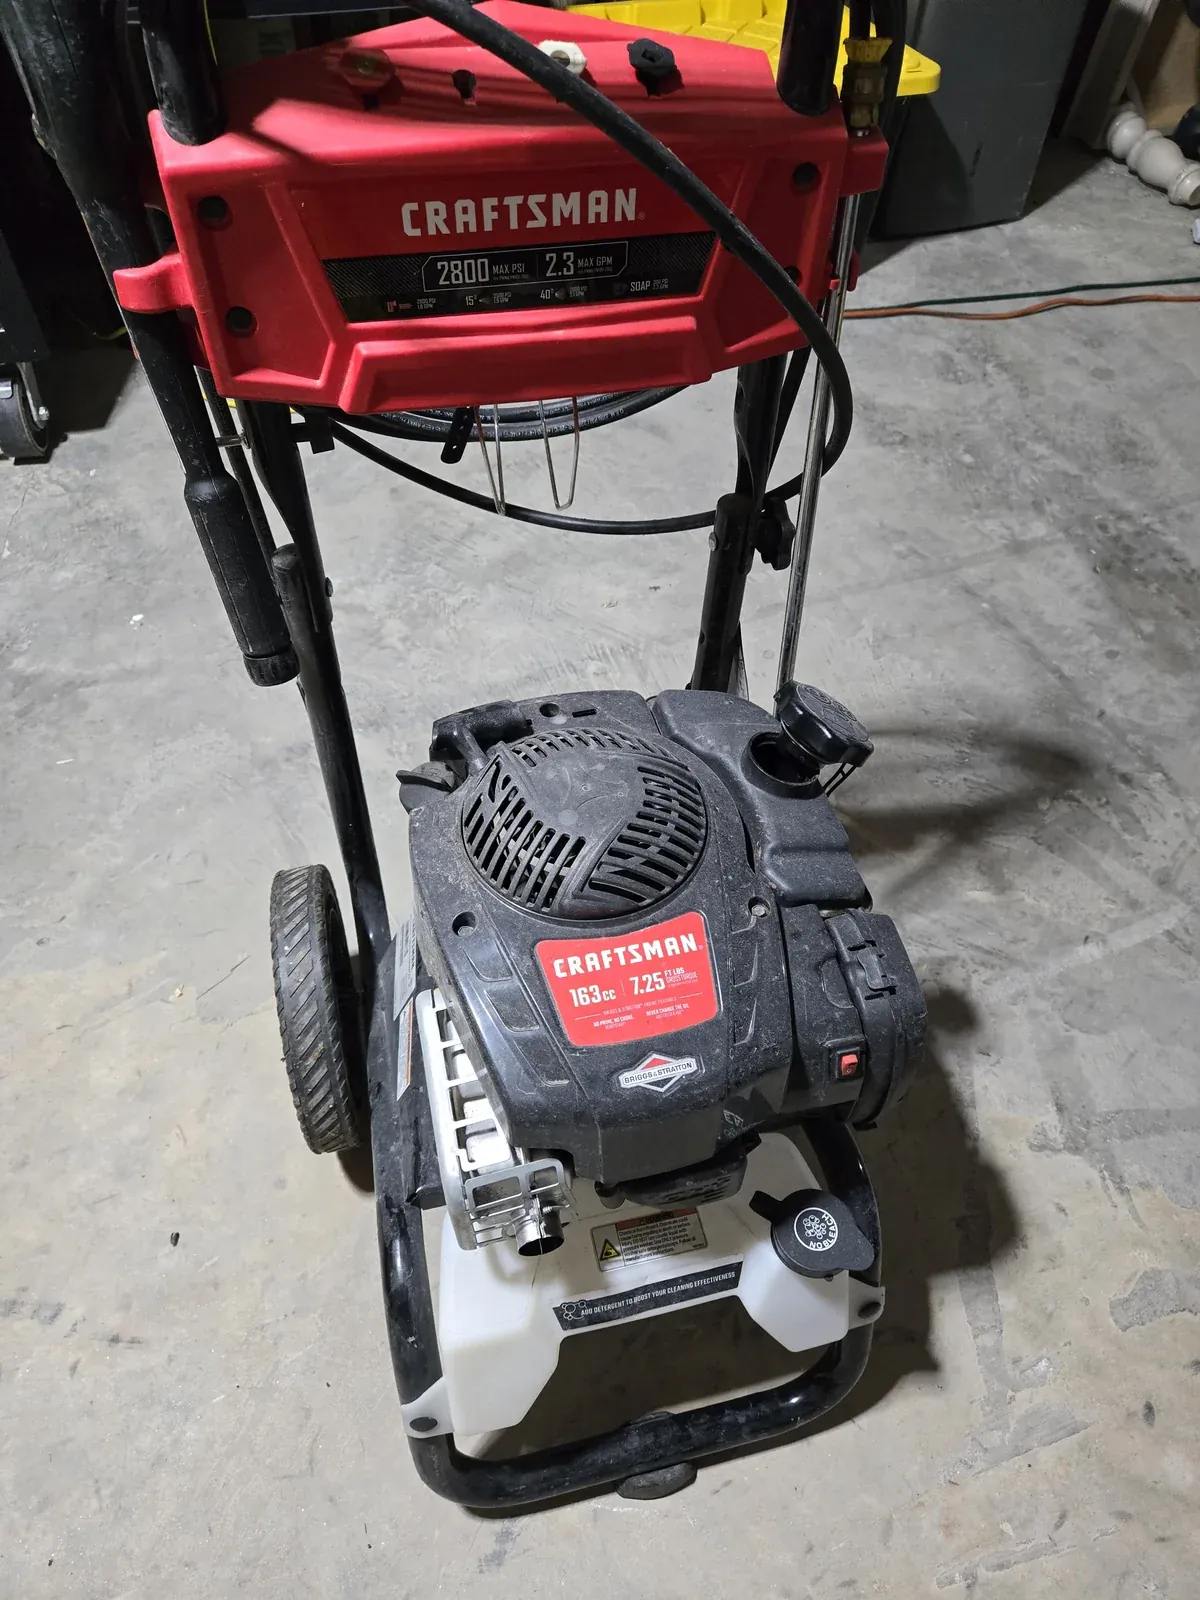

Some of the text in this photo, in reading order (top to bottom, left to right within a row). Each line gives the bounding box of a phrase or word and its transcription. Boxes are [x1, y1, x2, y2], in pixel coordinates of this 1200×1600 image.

[401, 188, 637, 236] CRAFTSMAN
[437, 258, 489, 285] 2800
[492, 264, 509, 274] MAX
[512, 263, 525, 273] PSI
[545, 252, 574, 277] 2.3
[577, 258, 594, 268] MAX
[596, 256, 613, 266] GPM
[630, 280, 651, 292] SOAP
[553, 933, 698, 979] CRAFTSMAN
[629, 972, 666, 996] 7.25
[664, 967, 685, 977] FT LBS
[581, 1271, 736, 1316] ADD DETERGENT TO BOOST YOUR CLEANING EFFECTIVENESS
